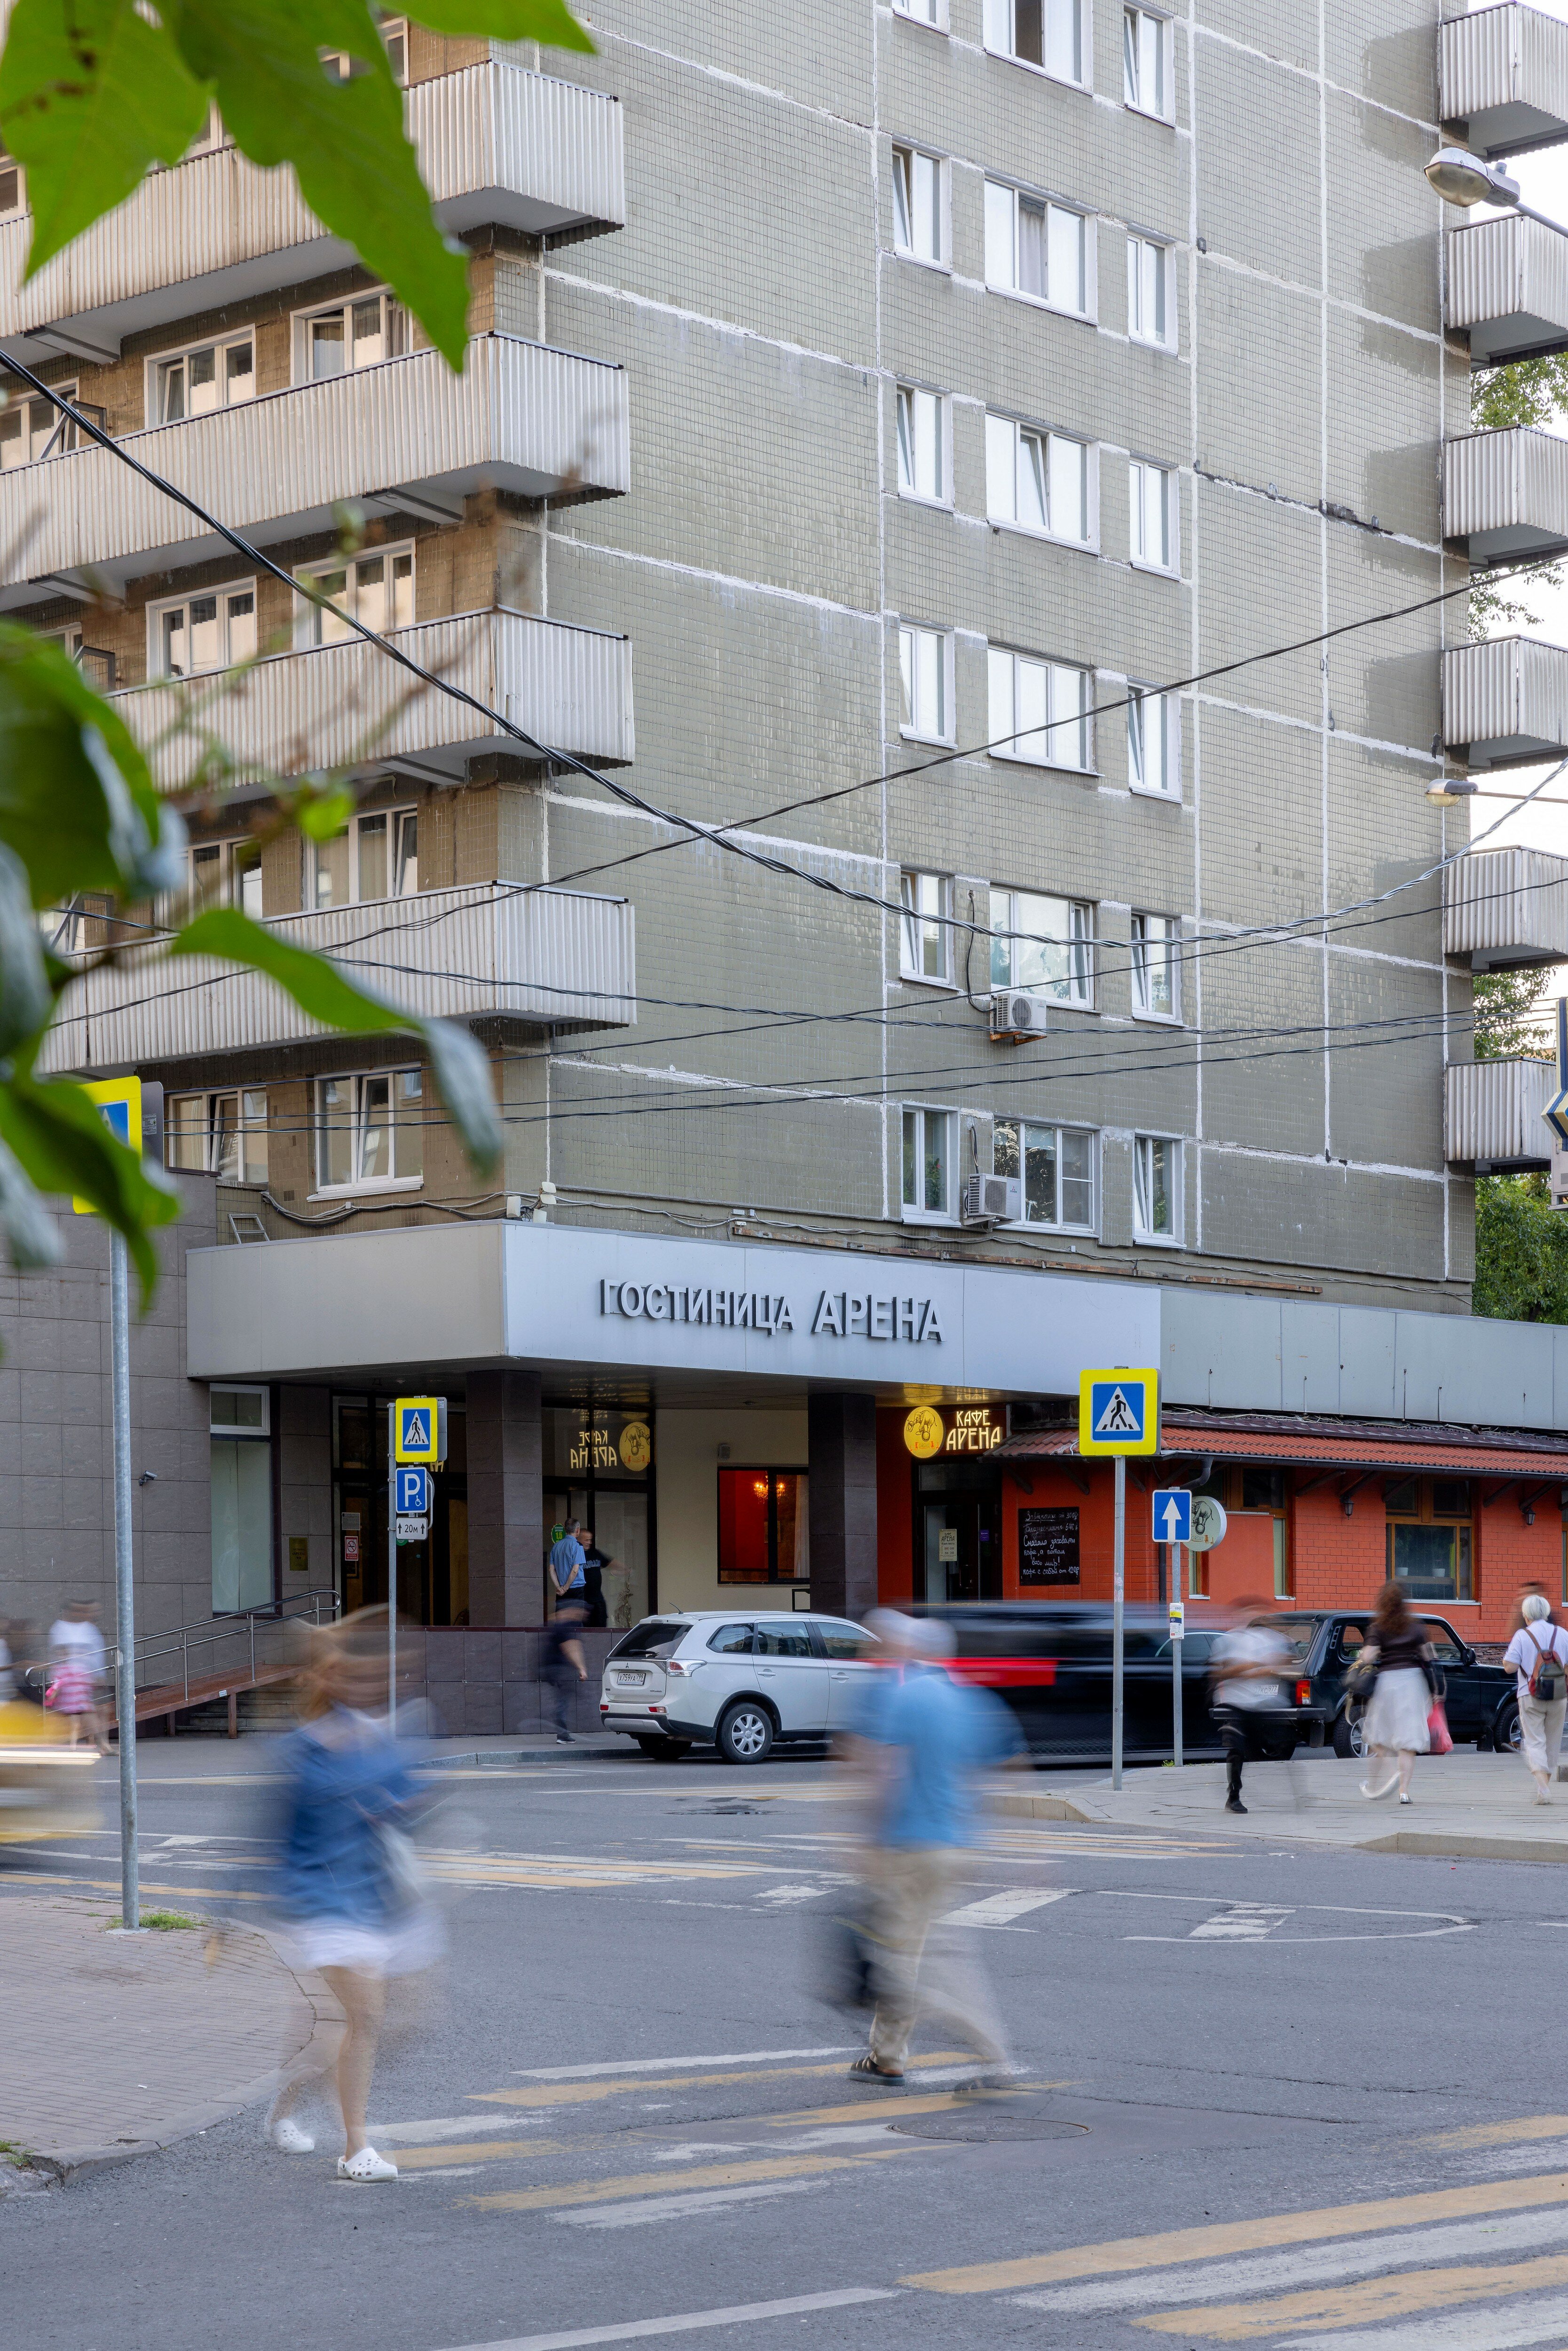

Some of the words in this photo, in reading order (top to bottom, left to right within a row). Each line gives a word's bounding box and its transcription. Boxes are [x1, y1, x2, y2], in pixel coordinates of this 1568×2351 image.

[600, 1278, 797, 1335] ГОСТИНИЦА
[812, 1290, 947, 1342] АРЕНА
[956, 1410, 990, 1427] КАФЕ
[946, 1427, 1001, 1451] АРЕНА
[1050, 1535, 1075, 1549] захвати
[1032, 1557, 1042, 1565] весь
[1044, 1556, 1060, 1570] мир!
[1023, 1568, 1036, 1578] кофе
